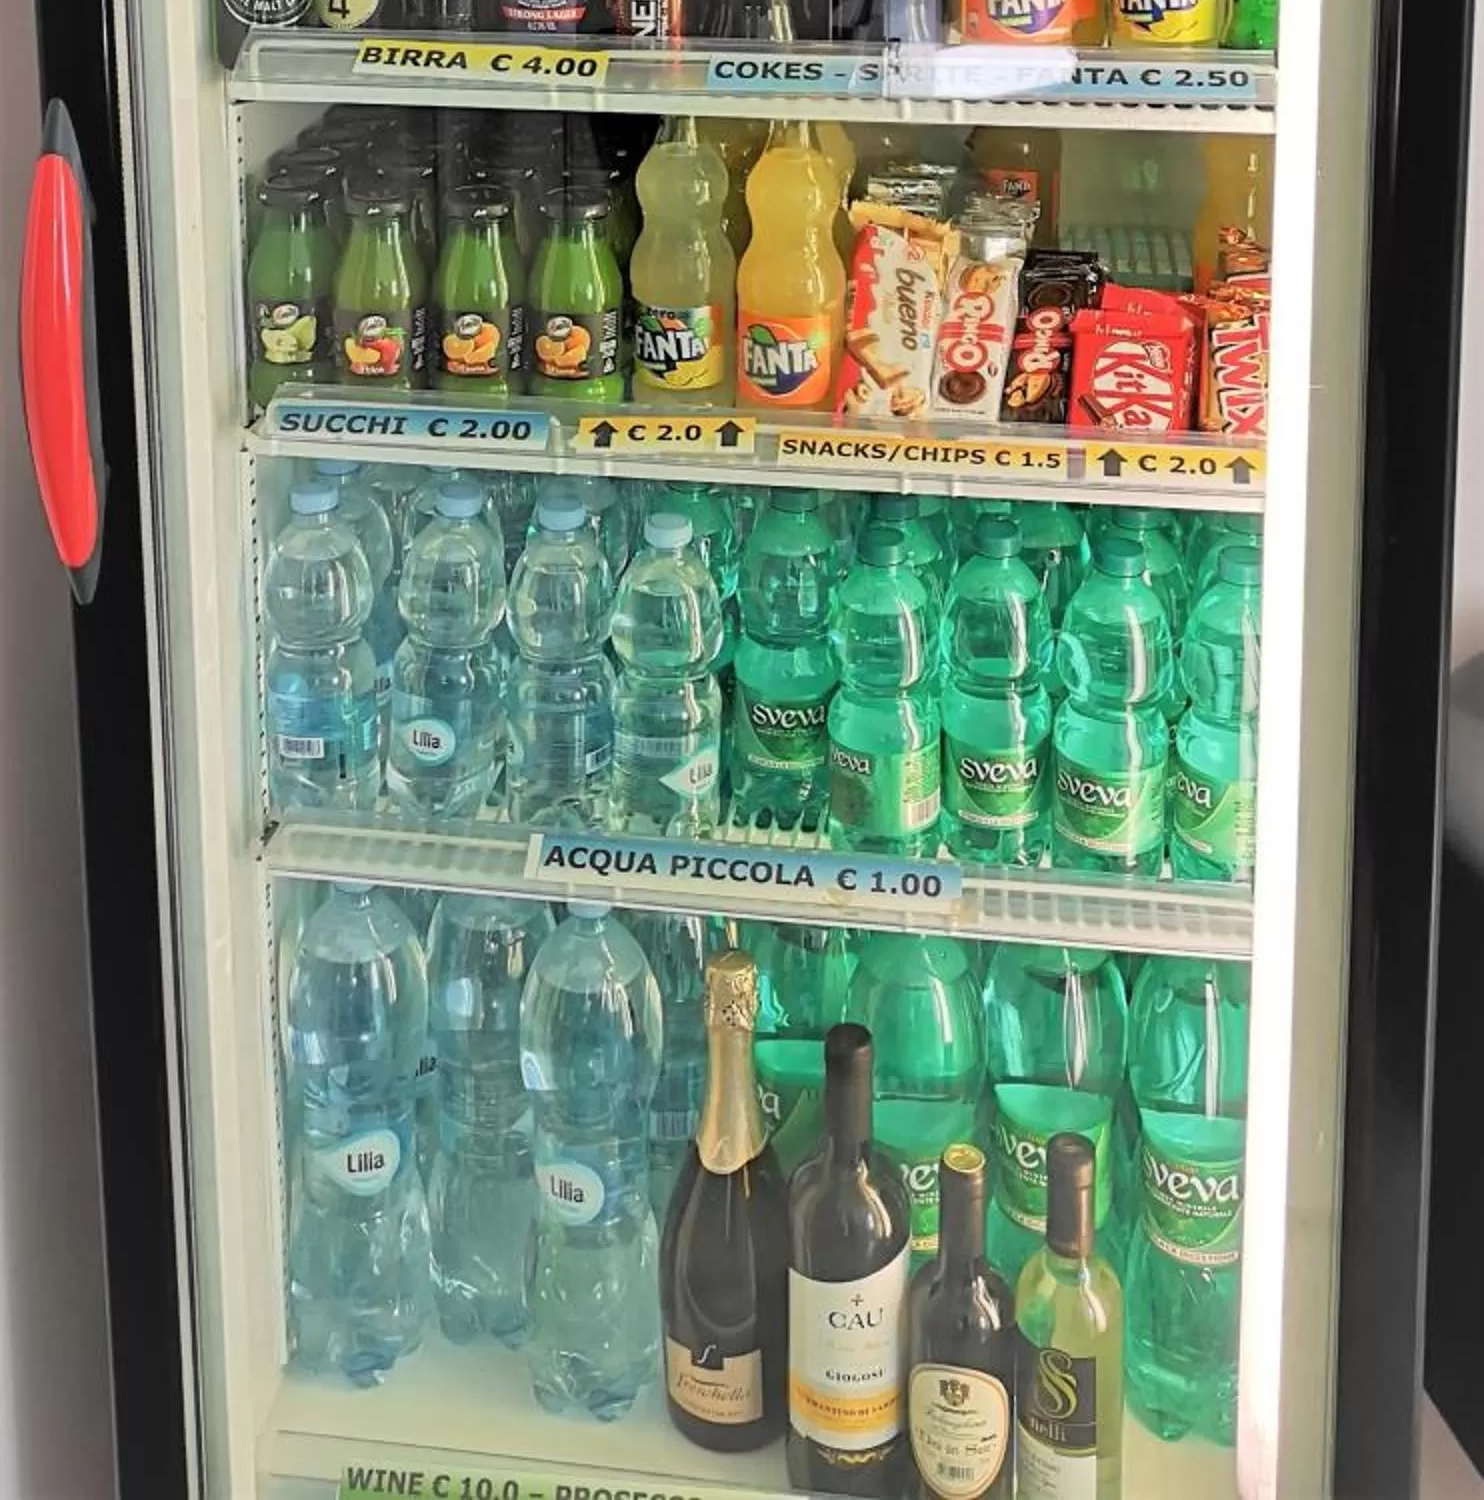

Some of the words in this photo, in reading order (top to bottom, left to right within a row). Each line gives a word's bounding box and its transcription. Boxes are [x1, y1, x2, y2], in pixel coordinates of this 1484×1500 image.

[253, 0, 283, 12] MALT
[361, 47, 467, 69] BIRRA
[522, 56, 598, 78] 4.00
[714, 61, 824, 82] COKES
[1140, 68, 1162, 86] €
[1175, 70, 1249, 88] 2.50
[896, 267, 926, 351] bueno
[635, 325, 706, 362] FANTA
[743, 337, 818, 376] FANTA
[1212, 314, 1270, 435] TWIX
[1094, 350, 1174, 430] KitKa
[279, 413, 408, 436] SUCCHI
[459, 420, 531, 441] 2.00
[627, 425, 647, 442] €
[656, 424, 702, 442] 2.0
[782, 438, 986, 465] SNACKS/CHIPS
[1021, 451, 1061, 469] 1.5
[1169, 456, 1217, 475] 2.0
[752, 703, 825, 729] sveva
[413, 728, 441, 750] Lilia
[831, 748, 871, 775] veva
[959, 756, 1037, 784] sveva
[1057, 771, 1133, 808] sveva
[1175, 771, 1212, 809] eva
[544, 845, 658, 876] ACQUA
[669, 855, 816, 888] PICCOLA
[836, 868, 857, 891] €
[869, 871, 942, 898] 1.00
[347, 1150, 386, 1174] Lilia
[550, 1174, 585, 1204] Lilia
[829, 1308, 884, 1331] CAU
[346, 1467, 425, 1496] WINE
[459, 1476, 520, 1500] 10.0
